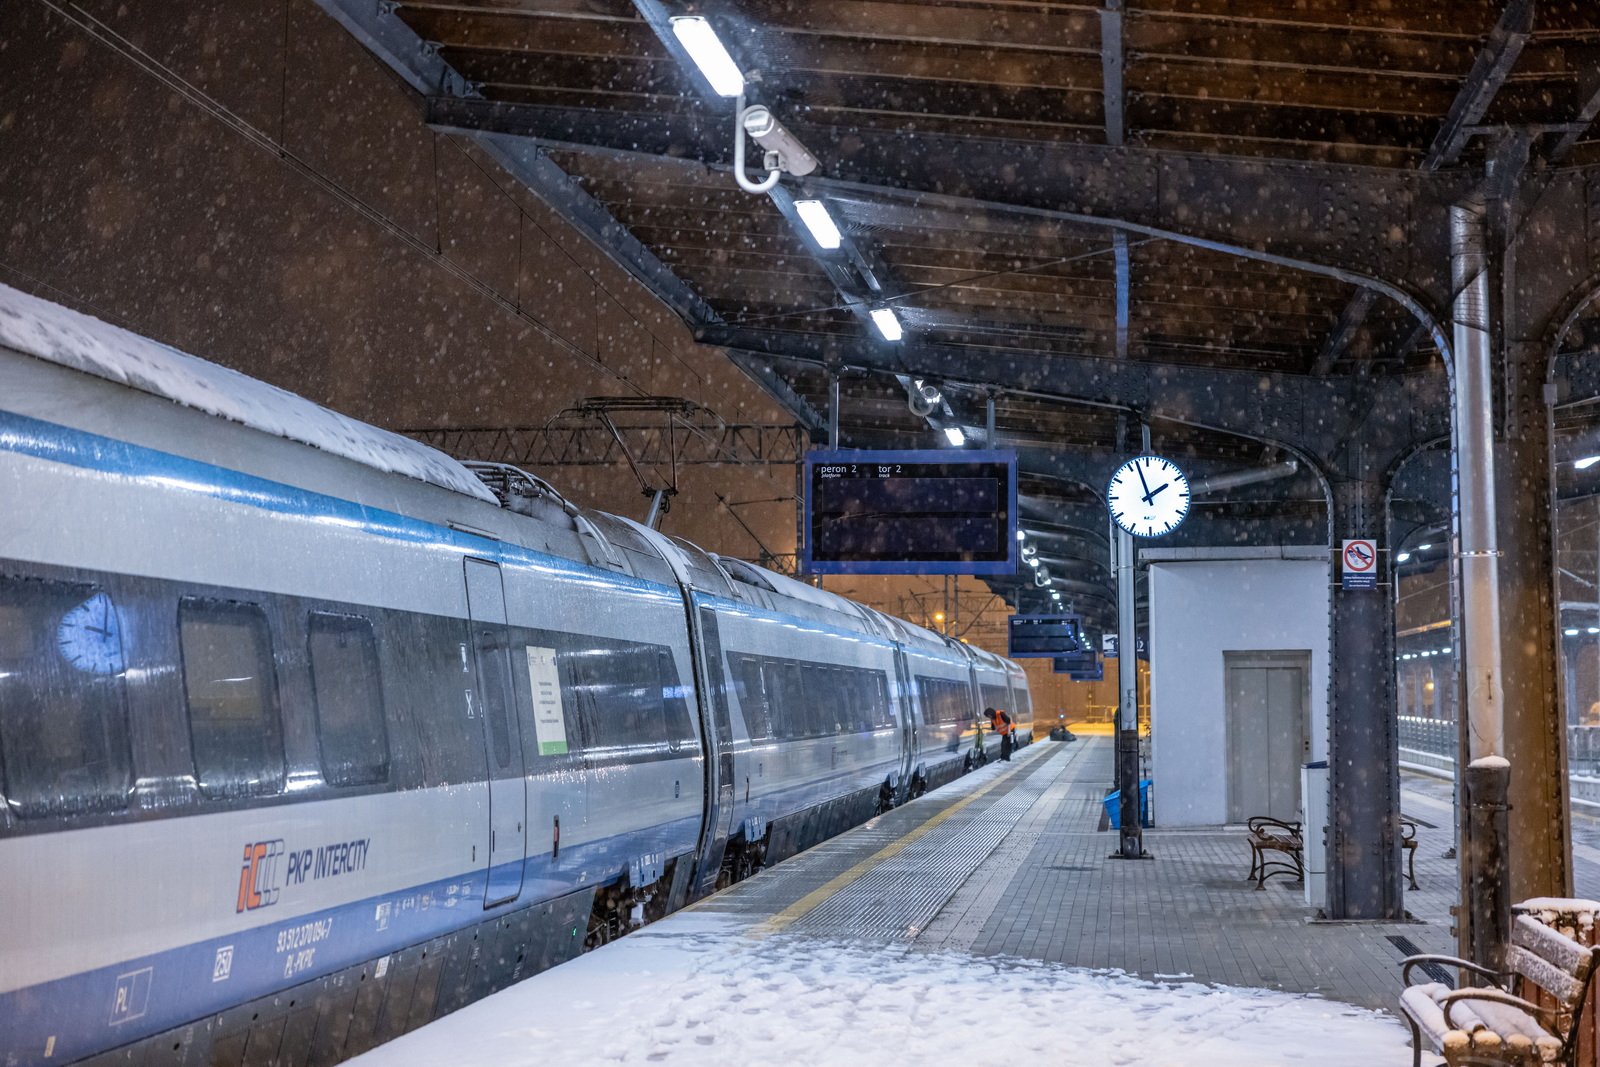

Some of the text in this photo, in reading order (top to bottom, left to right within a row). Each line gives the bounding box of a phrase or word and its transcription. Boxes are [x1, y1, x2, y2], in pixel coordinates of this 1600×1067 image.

[821, 465, 902, 474] peron 2 tor 2
[286, 838, 370, 887] PKP INTERCITY
[277, 931, 287, 953] 93
[214, 951, 232, 977] 250
[115, 987, 128, 1014] PL
